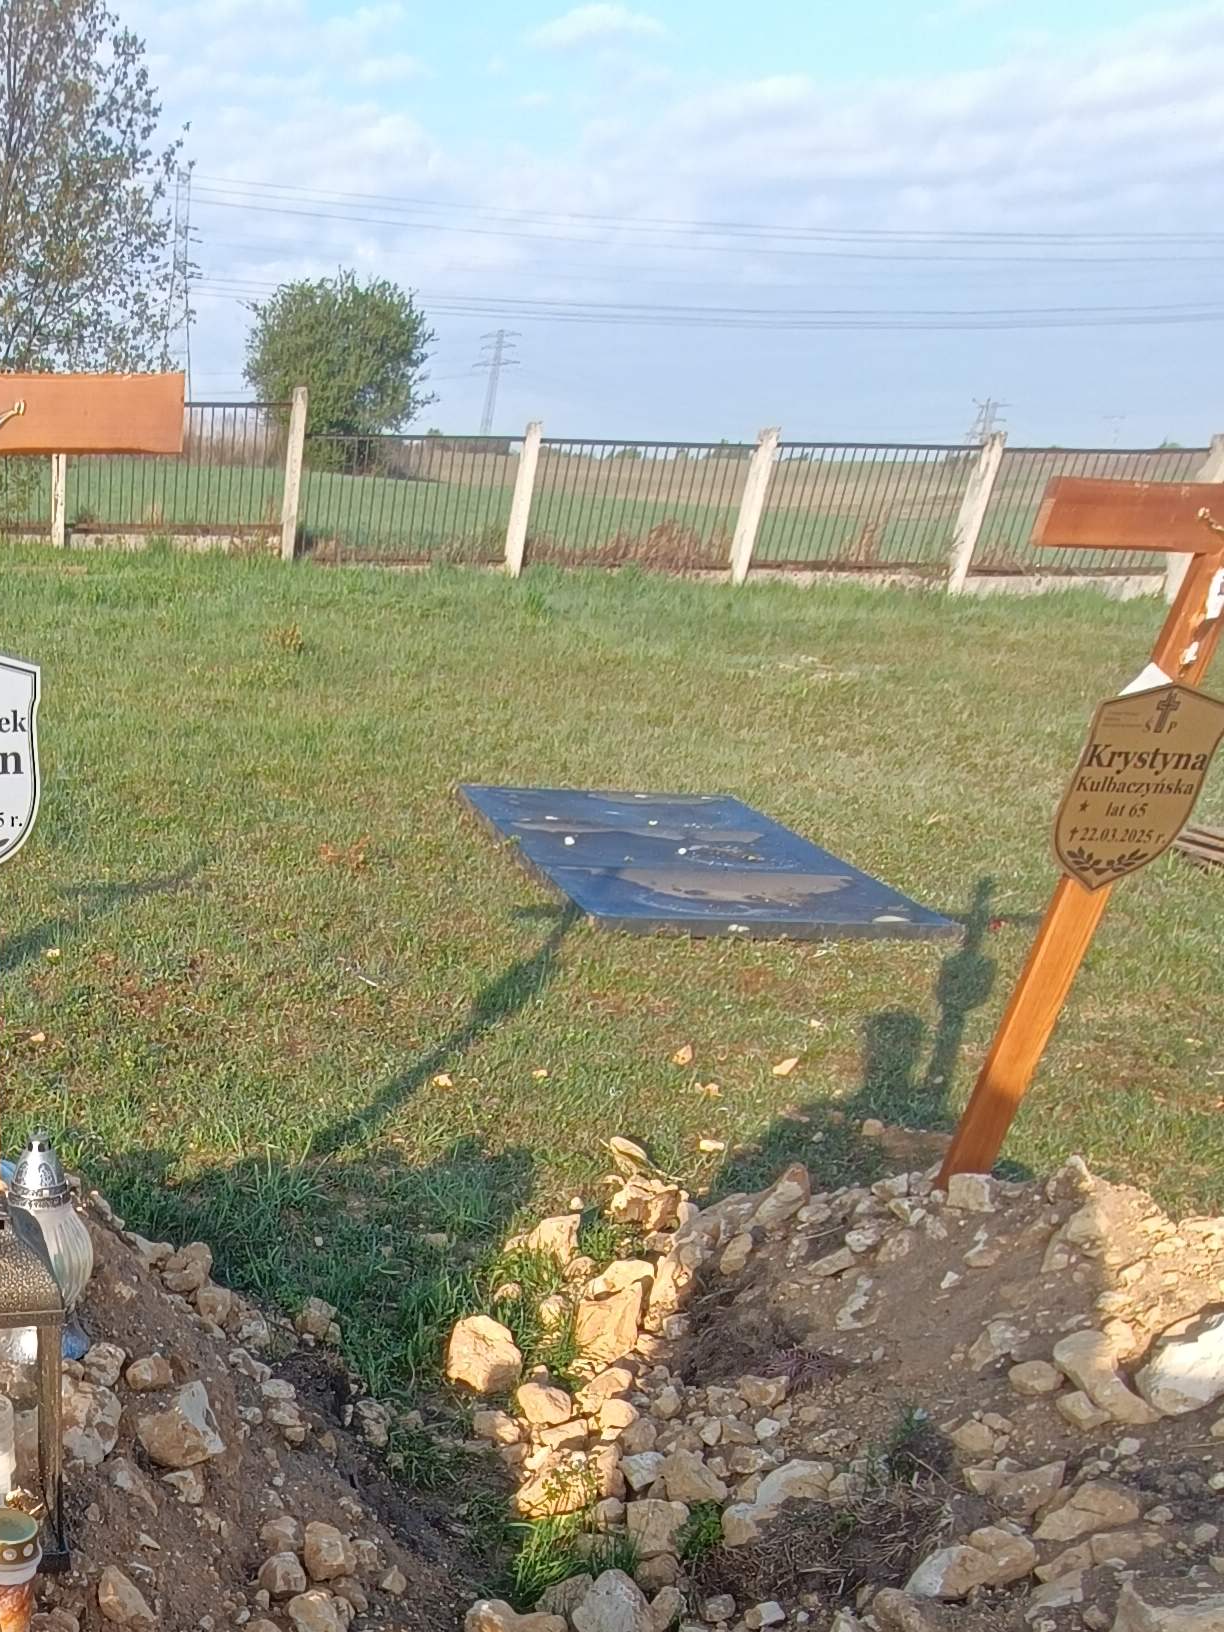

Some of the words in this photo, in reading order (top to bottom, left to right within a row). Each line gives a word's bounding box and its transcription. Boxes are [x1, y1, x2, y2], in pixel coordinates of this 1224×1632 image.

[1166, 721, 1177, 734] P
[1085, 744, 1208, 775] Krystyna
[1076, 776, 1194, 797] Kulbaczyńska
[1105, 802, 1125, 817] lat
[1129, 803, 1149, 818] 65
[10, 816, 23, 828] r.
[1080, 827, 1153, 843] 22.03.2025
[1154, 833, 1166, 844] r.
